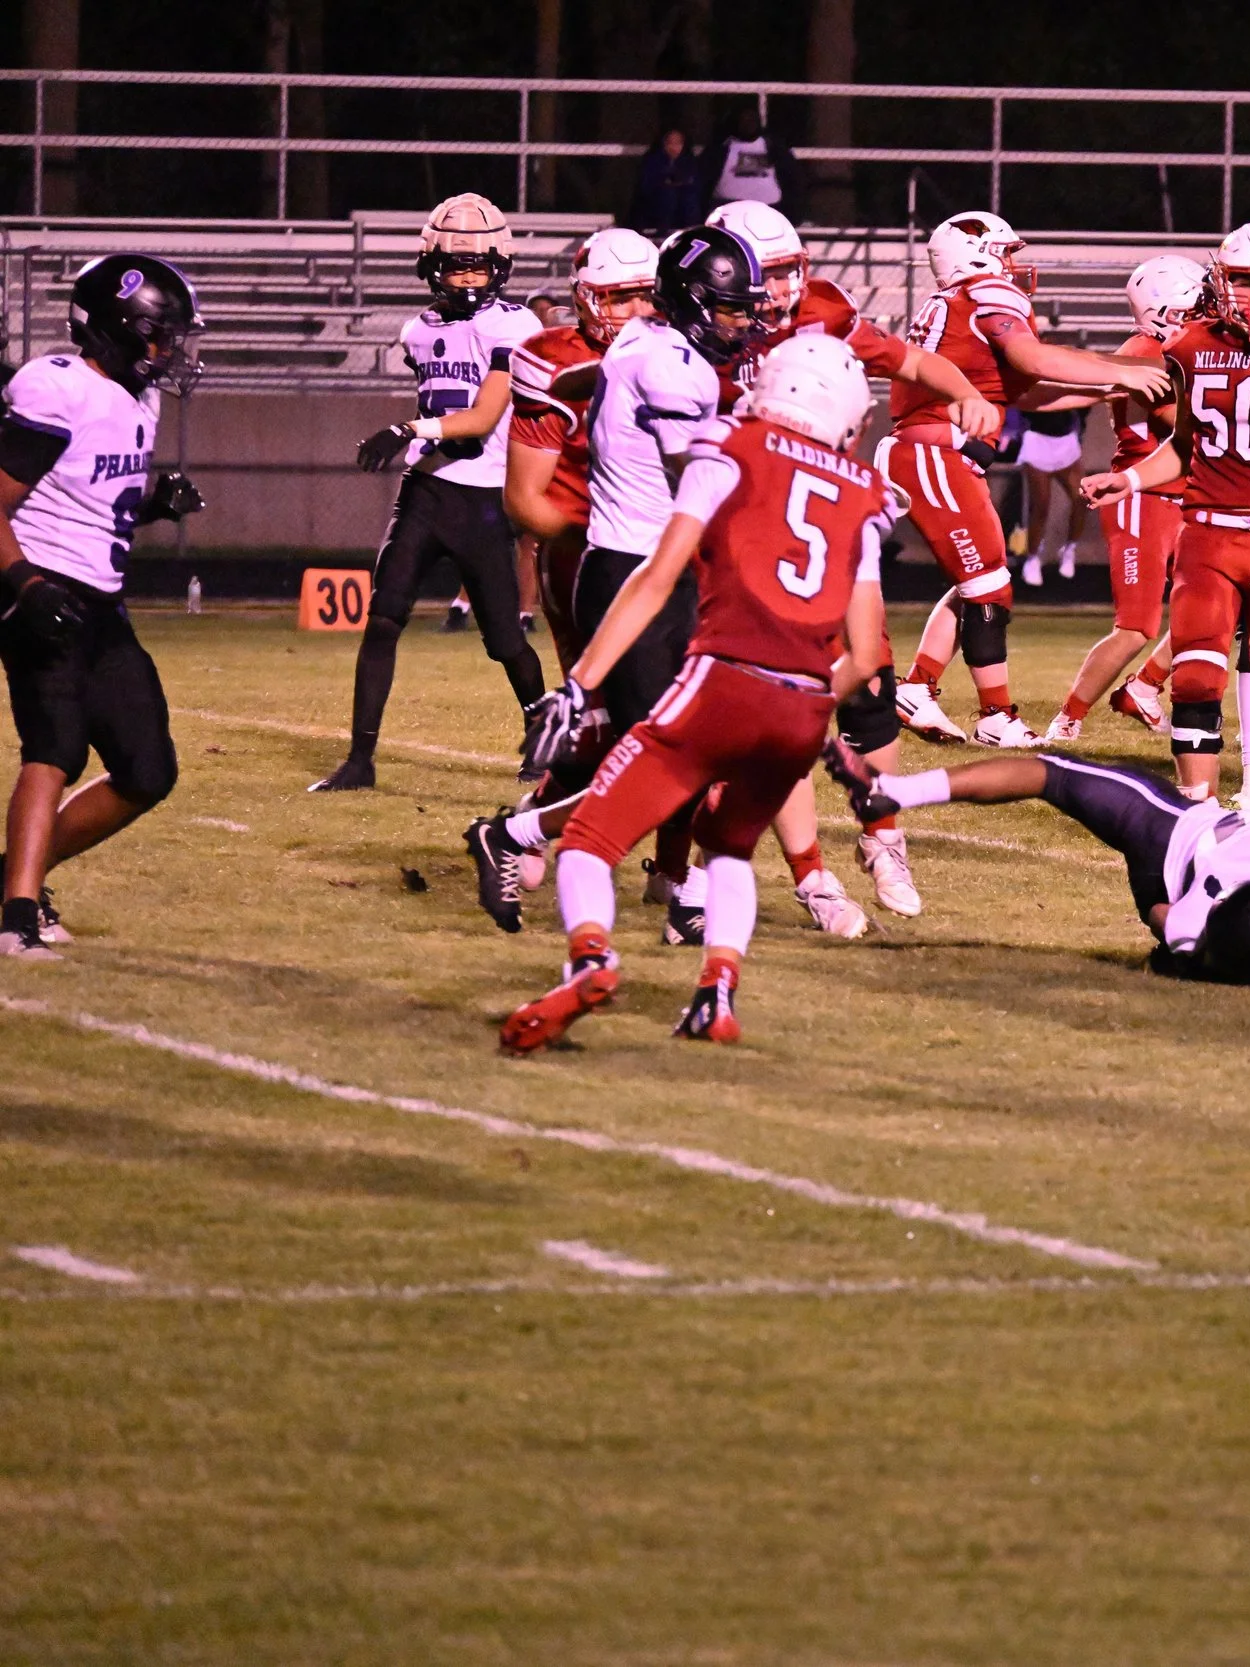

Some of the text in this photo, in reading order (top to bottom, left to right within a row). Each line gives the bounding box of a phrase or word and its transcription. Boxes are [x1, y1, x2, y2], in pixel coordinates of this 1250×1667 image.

[679, 239, 711, 268] 7
[116, 269, 144, 299] 9
[89, 452, 153, 485] PHARA
[765, 431, 872, 489] CARDINALS
[777, 468, 841, 600] 5
[949, 527, 985, 574] CARDS
[1123, 546, 1139, 585] CARDS
[317, 577, 363, 625] 30
[590, 733, 644, 796] CARDS
